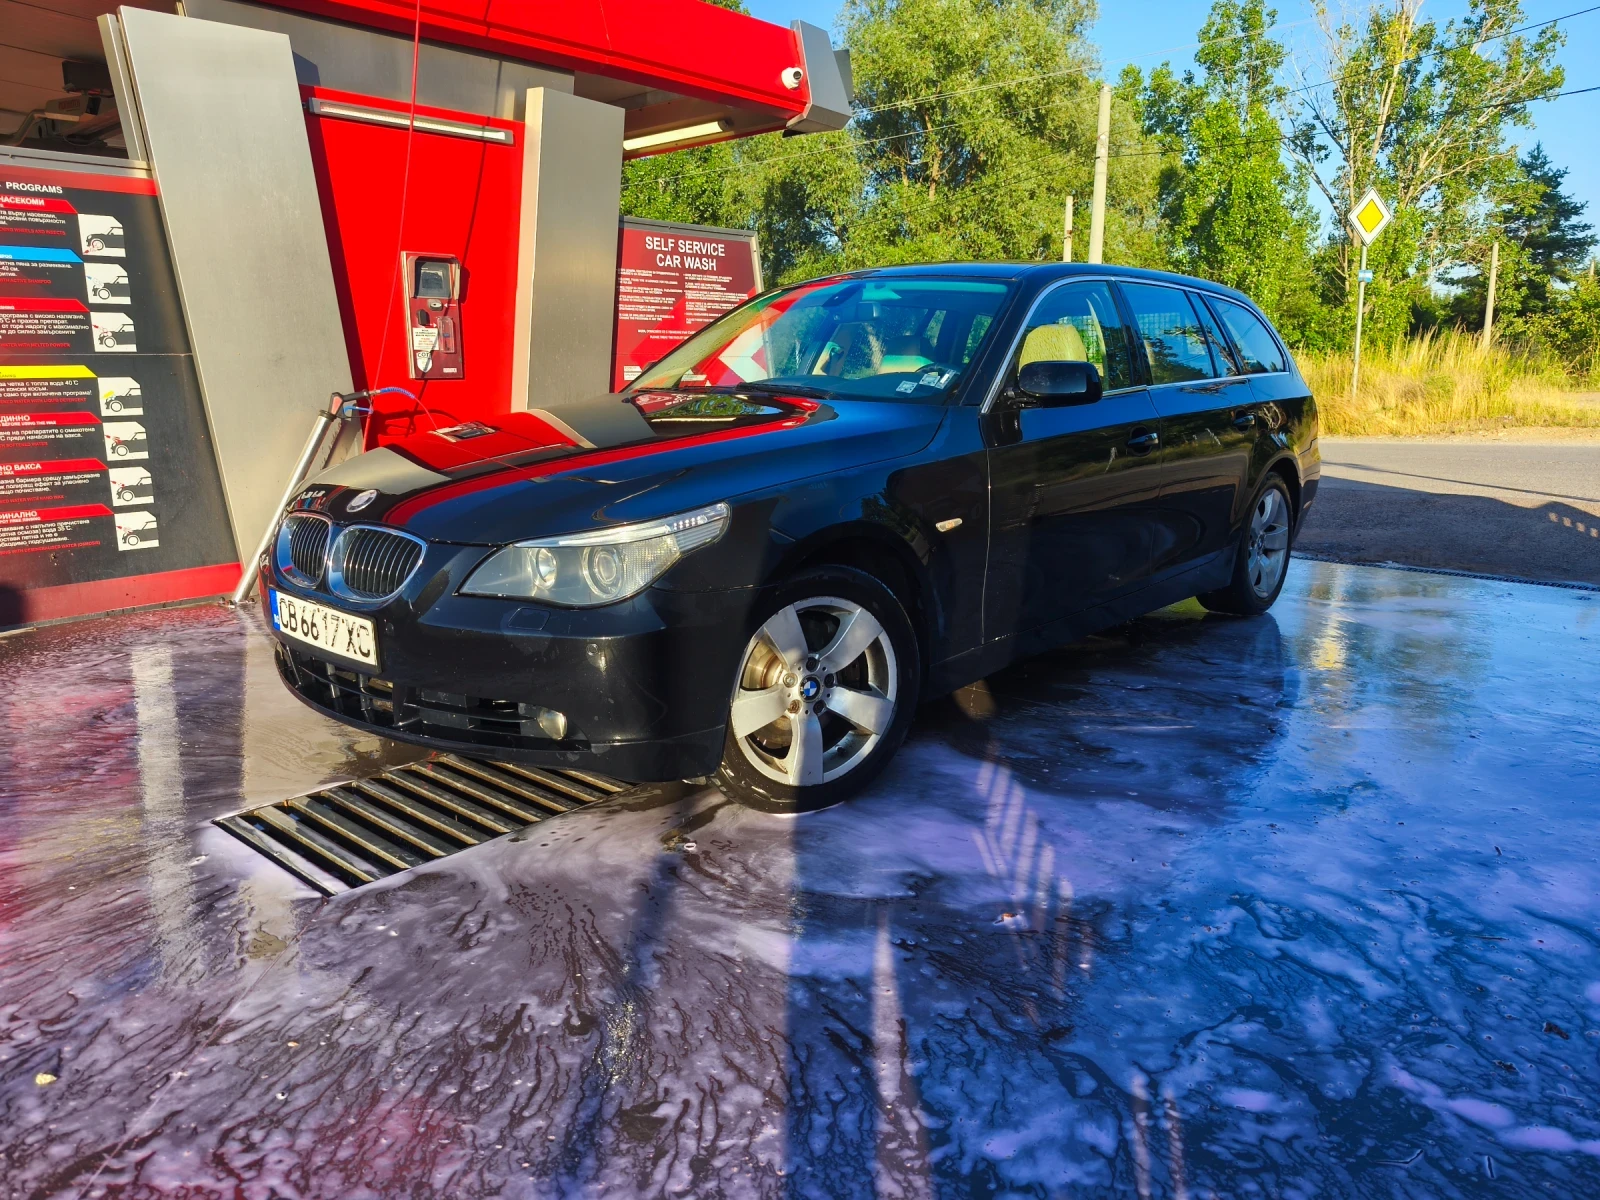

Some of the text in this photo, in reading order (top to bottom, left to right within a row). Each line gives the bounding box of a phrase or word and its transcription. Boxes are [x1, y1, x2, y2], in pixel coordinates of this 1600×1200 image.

[5, 181, 63, 194] PROGRAMS
[645, 236, 725, 257] SELF SERVICE
[656, 254, 717, 271] CAR WASH
[14, 463, 42, 471] ВАКСА
